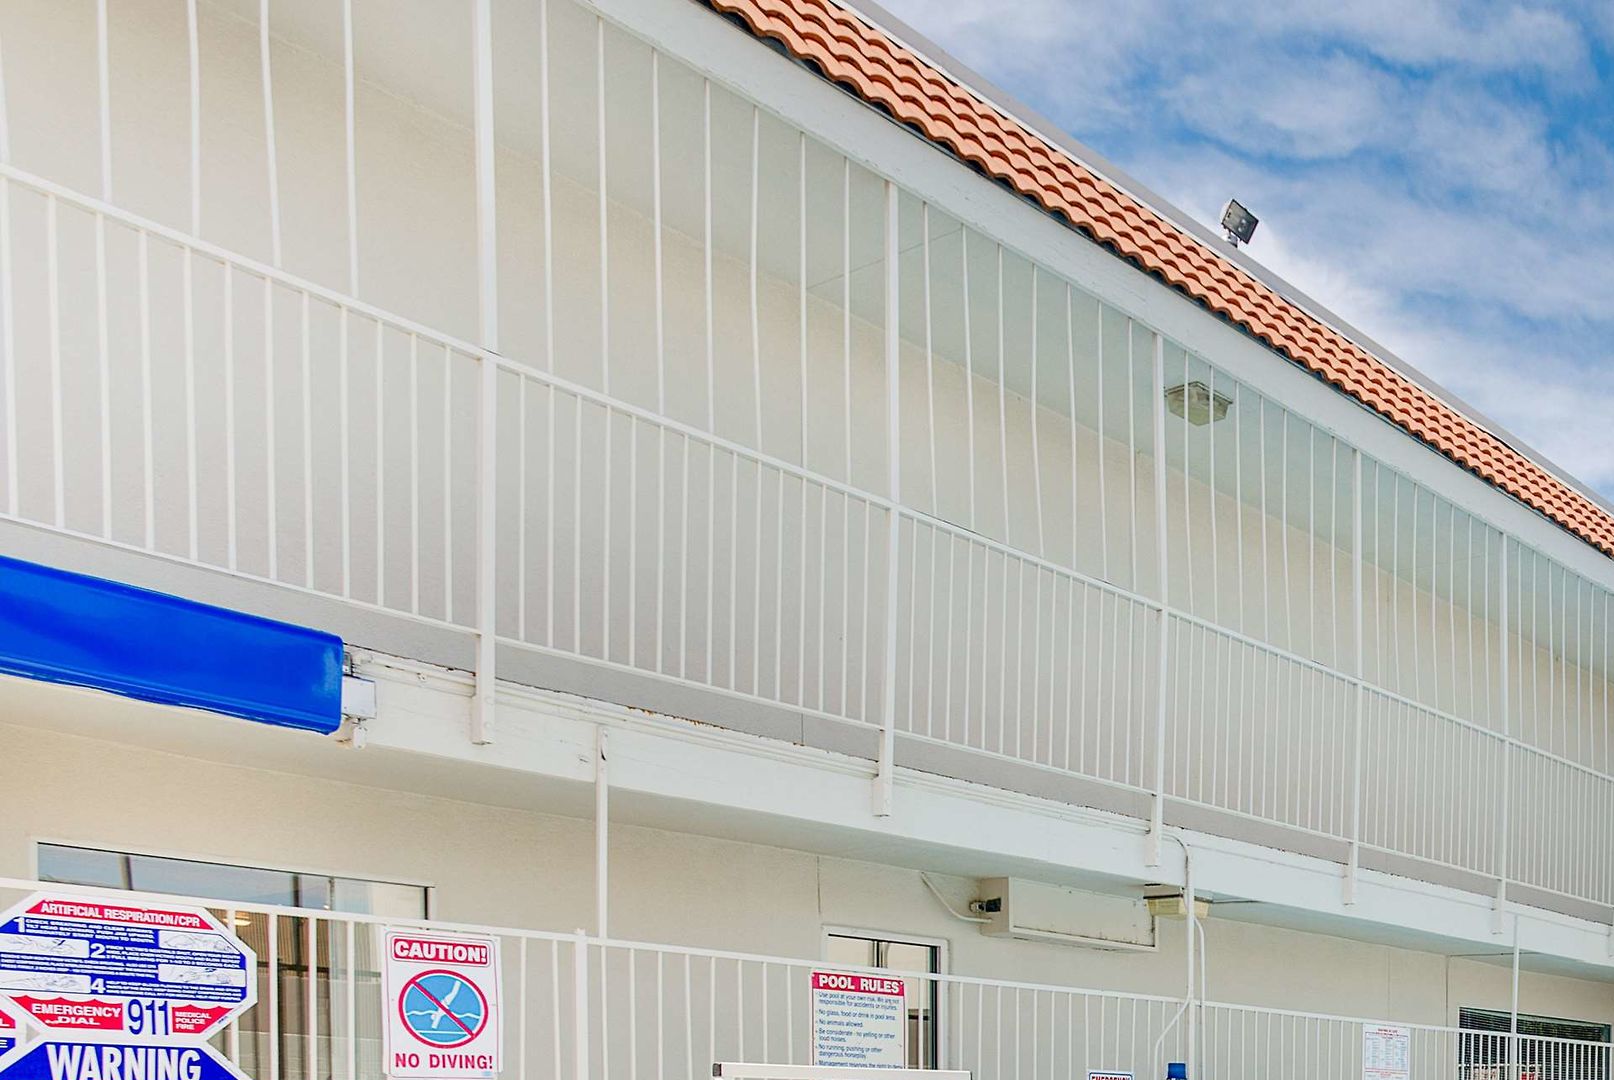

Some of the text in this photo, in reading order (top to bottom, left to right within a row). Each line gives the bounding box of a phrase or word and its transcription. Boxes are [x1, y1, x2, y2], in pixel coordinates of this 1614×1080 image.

[41, 902, 200, 927] ARTIFICIAL RESPIRATION/CPR
[15, 916, 25, 932] 1
[90, 943, 105, 959] 2
[395, 941, 487, 962] CAUTION!
[91, 978, 106, 994] 4
[819, 975, 899, 994] POOL RULES
[32, 1003, 121, 1018] EMERGENCY
[128, 999, 168, 1035] 911
[175, 1011, 211, 1020] MEDICAL
[57, 1016, 100, 1026] DIAL
[175, 1017, 205, 1026] POLICE
[175, 1023, 195, 1031] FIRE
[395, 1053, 493, 1069] NO DIVING!
